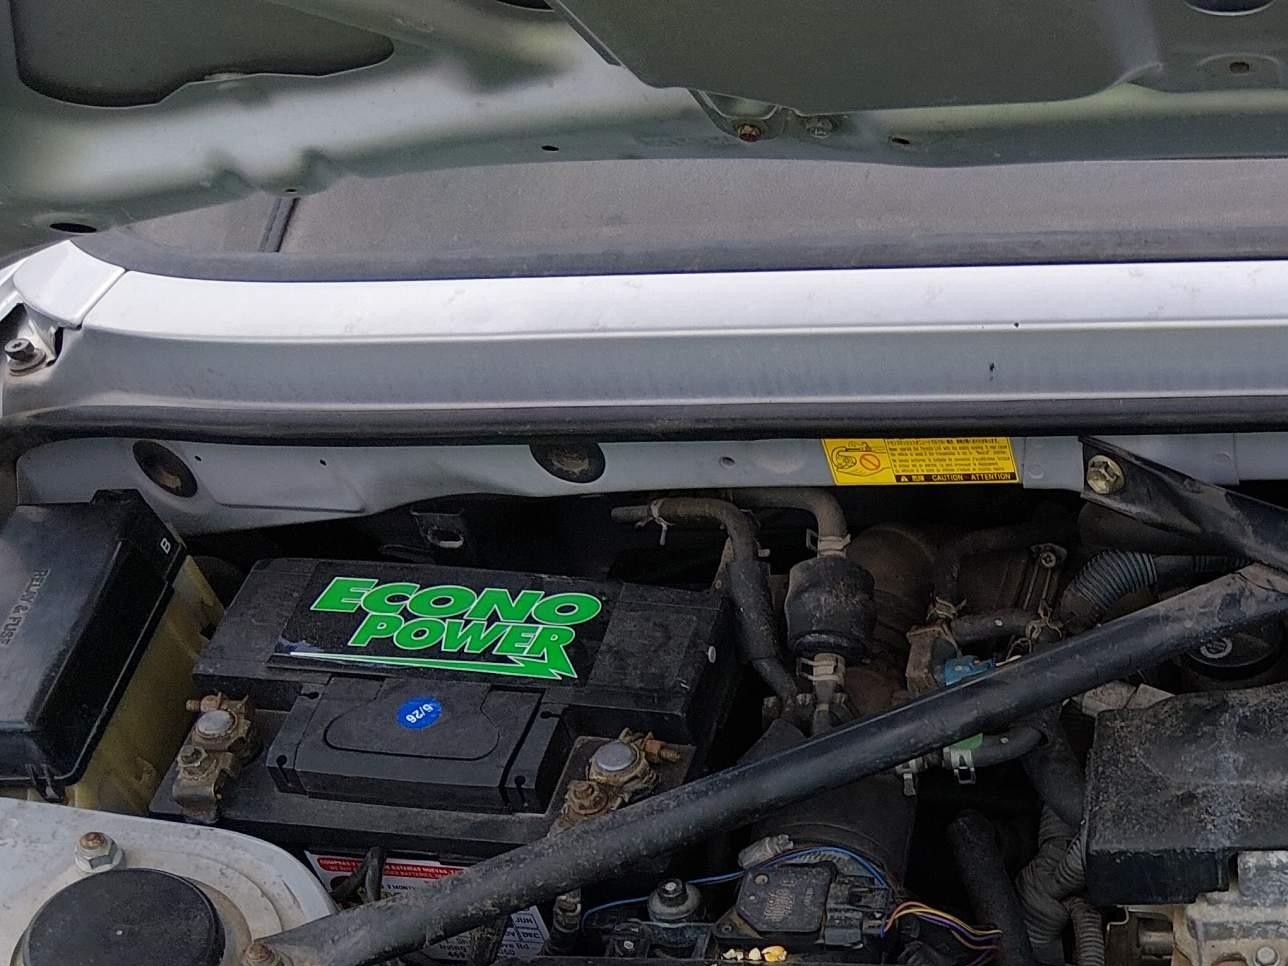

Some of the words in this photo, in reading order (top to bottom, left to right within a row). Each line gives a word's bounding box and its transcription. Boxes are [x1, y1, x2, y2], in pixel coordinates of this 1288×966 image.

[971, 473, 1011, 481] ATTENTION
[160, 537, 171, 554] B
[310, 577, 602, 625] ECONO
[348, 613, 577, 672] POWER
